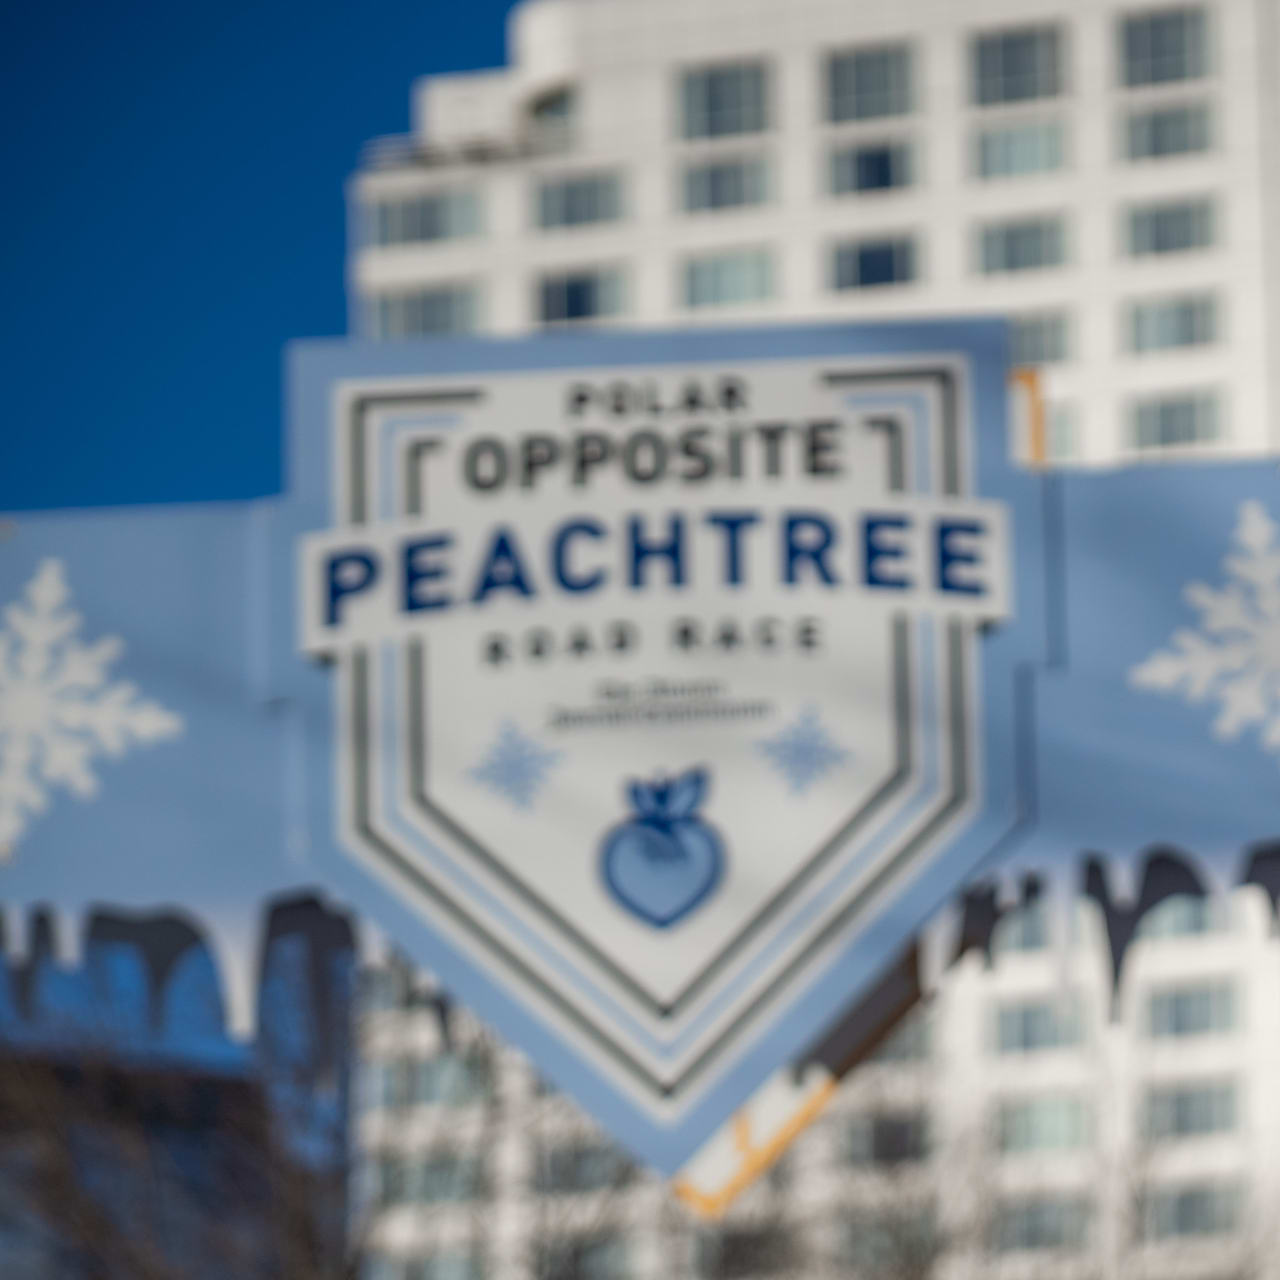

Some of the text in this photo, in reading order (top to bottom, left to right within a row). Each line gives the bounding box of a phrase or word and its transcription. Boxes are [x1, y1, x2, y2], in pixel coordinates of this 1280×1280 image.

[568, 376, 749, 417] POLAR
[462, 417, 846, 494] OPPOSITE
[322, 510, 988, 628] PEACHTREE
[482, 613, 826, 667] ROAD RACE
